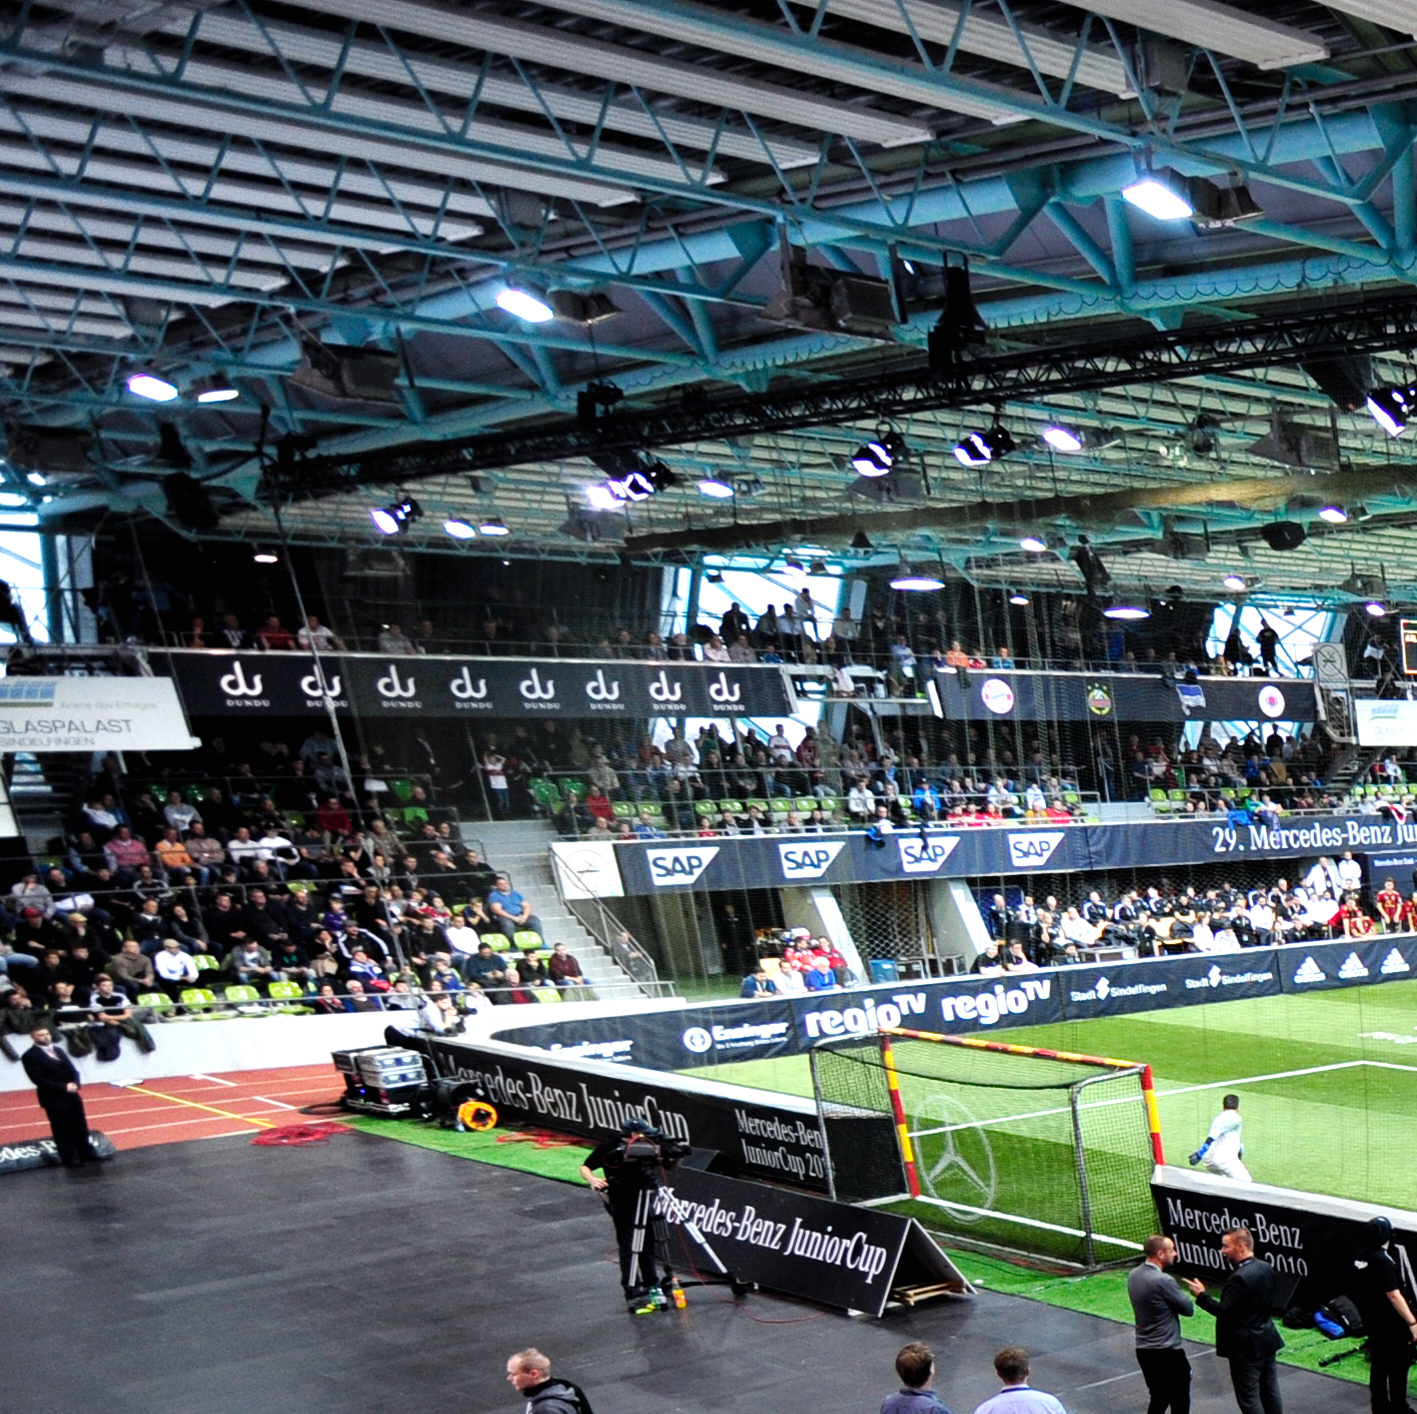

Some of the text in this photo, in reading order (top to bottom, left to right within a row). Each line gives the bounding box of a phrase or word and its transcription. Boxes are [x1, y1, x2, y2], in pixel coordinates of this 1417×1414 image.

[1212, 826, 1245, 852] 29.
[1250, 821, 1392, 851] Mercedes-Benz
[784, 850, 830, 870] SAP
[903, 845, 946, 866] SAP
[1012, 839, 1052, 860] SAP
[652, 855, 704, 877] SAP
[1185, 970, 1273, 989] Stadt Sindelfingen
[1070, 982, 1167, 1002] Stadt Sindelfingen
[741, 1139, 806, 1181] JuniorCup
[653, 1186, 888, 1285] Mercedes-Benz JuniorCup
